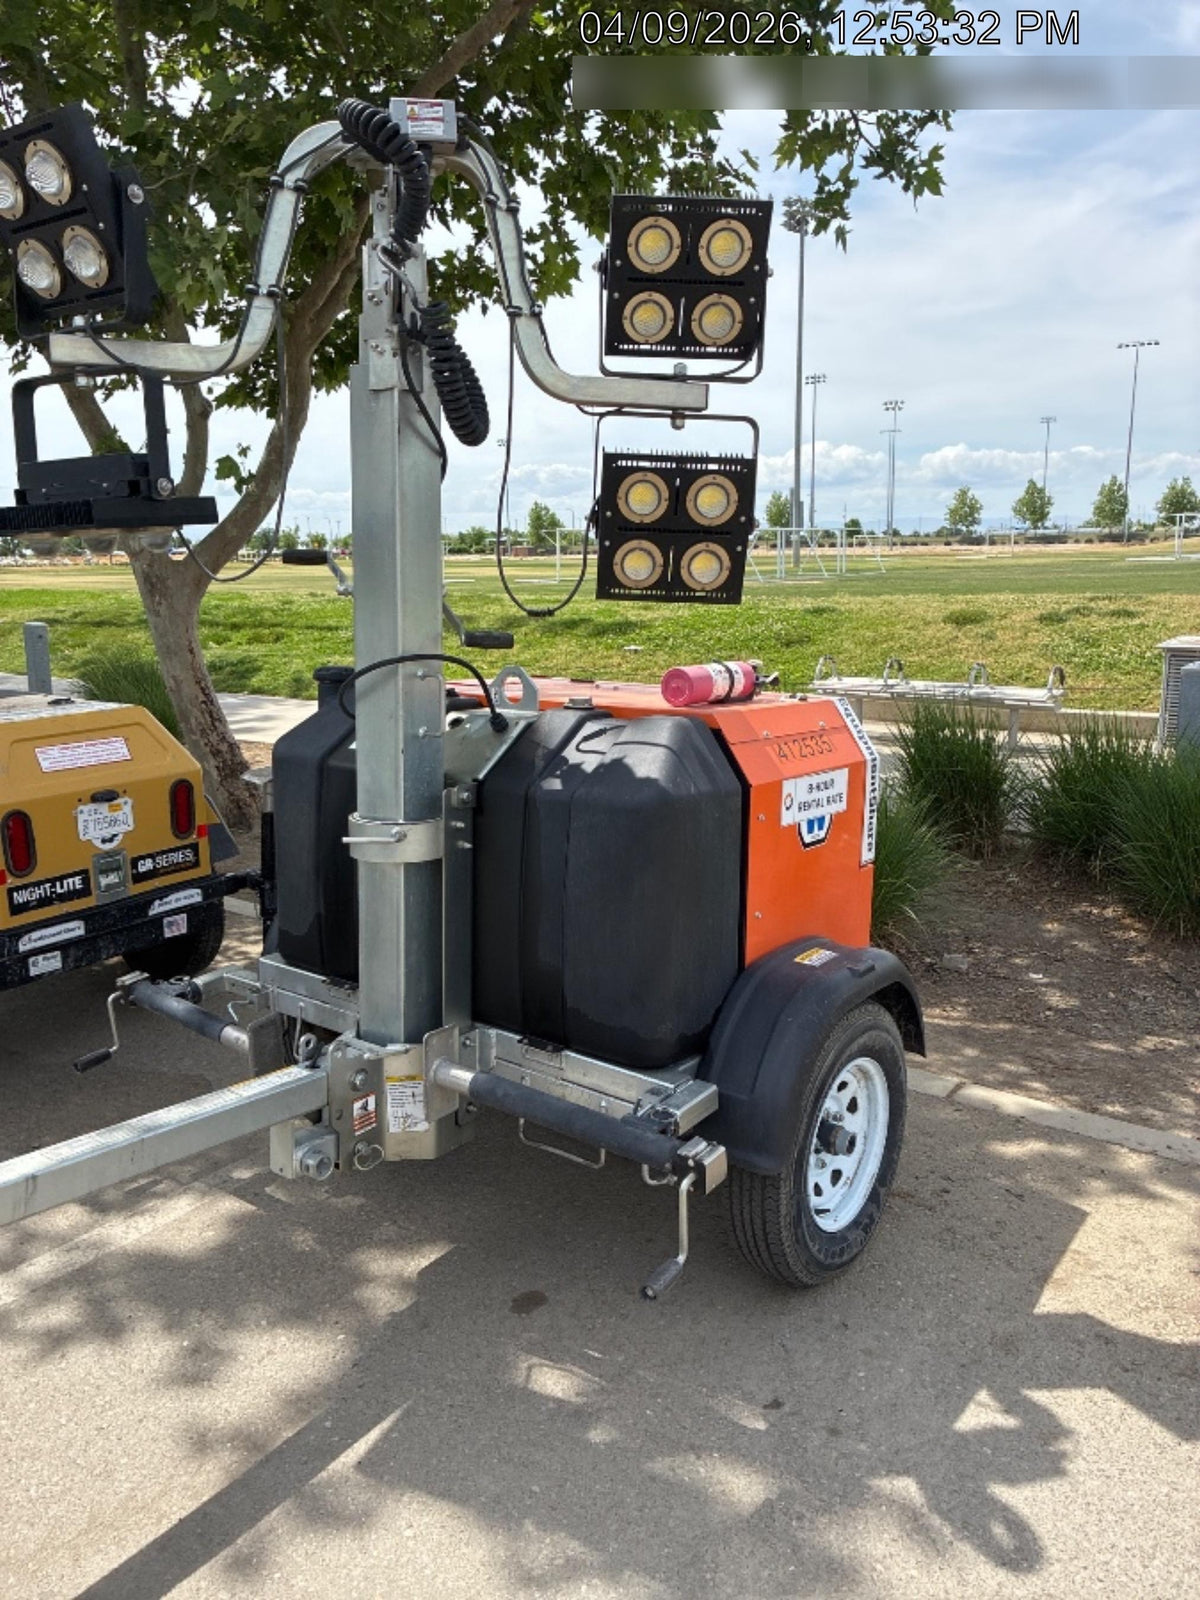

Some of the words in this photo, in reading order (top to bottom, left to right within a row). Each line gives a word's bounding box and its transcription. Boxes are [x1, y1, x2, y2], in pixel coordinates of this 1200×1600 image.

[777, 734, 833, 761] 412535
[137, 849, 194, 873] GR-SERIES
[12, 875, 84, 905] NIGHT-LITE
